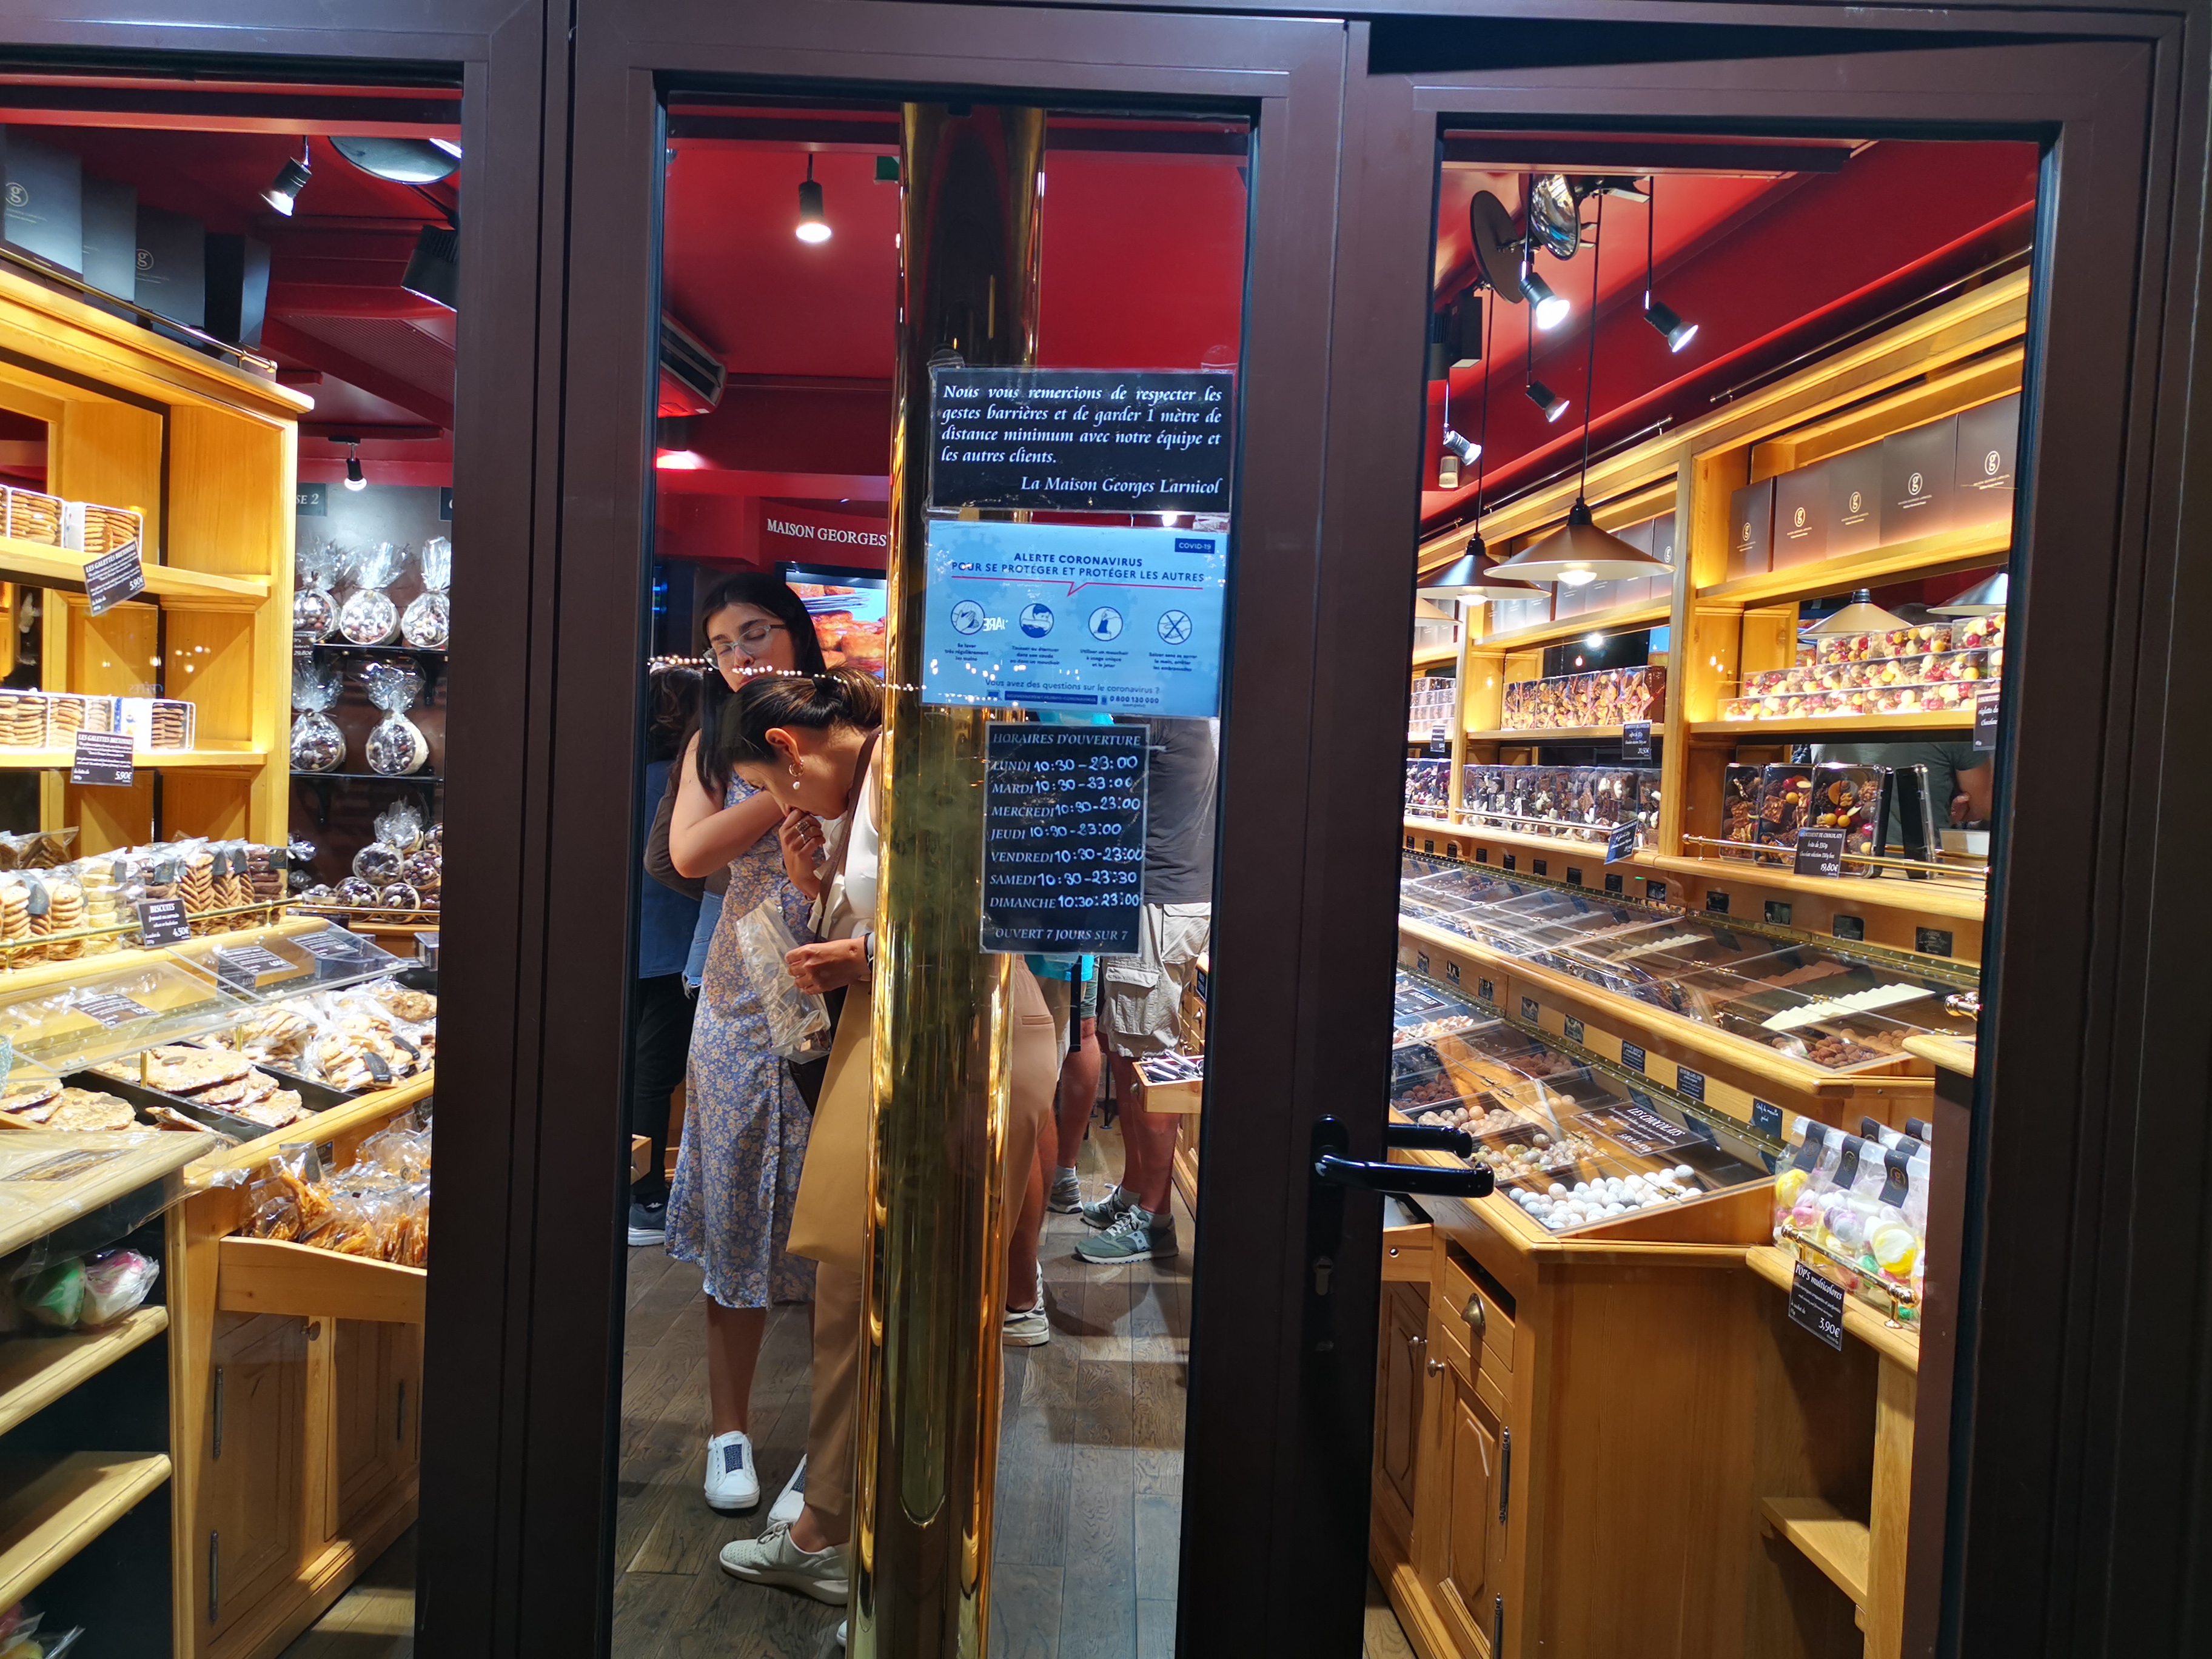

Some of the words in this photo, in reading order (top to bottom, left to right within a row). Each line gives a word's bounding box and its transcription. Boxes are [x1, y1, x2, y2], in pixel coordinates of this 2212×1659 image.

[943, 385, 979, 399] Nous
[988, 387, 1019, 398] vous
[1028, 387, 1102, 400] remercions
[1111, 385, 1127, 400] de
[1136, 389, 1196, 405] respecter
[1205, 386, 1222, 401] les
[941, 406, 980, 424] gestes
[987, 404, 1048, 420] barrières
[1054, 408, 1067, 420] et
[1073, 405, 1089, 421] de
[1093, 406, 1142, 427] garder
[1147, 409, 1153, 421] 1
[1161, 408, 1199, 423] mètre
[1205, 406, 1221, 423] de
[941, 426, 998, 440] distance
[1004, 429, 1073, 442] minimum
[1079, 431, 1109, 443] avec
[1115, 431, 1151, 443] notre
[1157, 431, 1202, 450] équipe
[1208, 432, 1220, 445] et
[941, 446, 957, 461] les
[962, 449, 1005, 461] autres
[1009, 447, 1056, 463] clients.
[1021, 477, 1039, 490] La
[1045, 478, 1097, 491] Maison
[1102, 478, 1154, 498] Georges
[1160, 478, 1222, 494] Larnicol
[310, 493, 319, 504] 2
[767, 518, 815, 538] MAISON
[817, 528, 887, 546] GEORGES
[1014, 553, 1055, 564] ALERTE
[1059, 555, 1142, 567] CORONAVIRUS
[952, 561, 982, 572] POUR
[986, 563, 997, 572] SE
[1062, 567, 1074, 575] ET
[1079, 566, 1136, 579] PROTÉGER
[1140, 571, 1158, 580] LES
[1162, 572, 1204, 582] AUTRES
[985, 679, 1004, 687] Vous
[1107, 685, 1153, 694] coronavirus
[993, 733, 1053, 743] HORAIRES
[1057, 734, 1141, 746] D'OUVERTURE
[991, 761, 1030, 771] LUNDI
[992, 783, 1033, 794] MARDI
[991, 806, 1054, 817] MERCREDI
[990, 829, 1025, 840] JEUDI
[991, 852, 1053, 863] VENDREDI
[990, 874, 1036, 885] SAMEDI
[150, 903, 175, 913] BISCUITS
[990, 897, 1056, 909] DIMANCHE
[995, 928, 1044, 939] OUVERT
[1047, 929, 1053, 939] 7
[1054, 929, 1091, 941] JOURS
[1094, 930, 1114, 940] SUR
[1121, 931, 1128, 940] 7
[1811, 1276, 1842, 1300] multicolores
[1818, 1317, 1840, 1338] 3,90€
